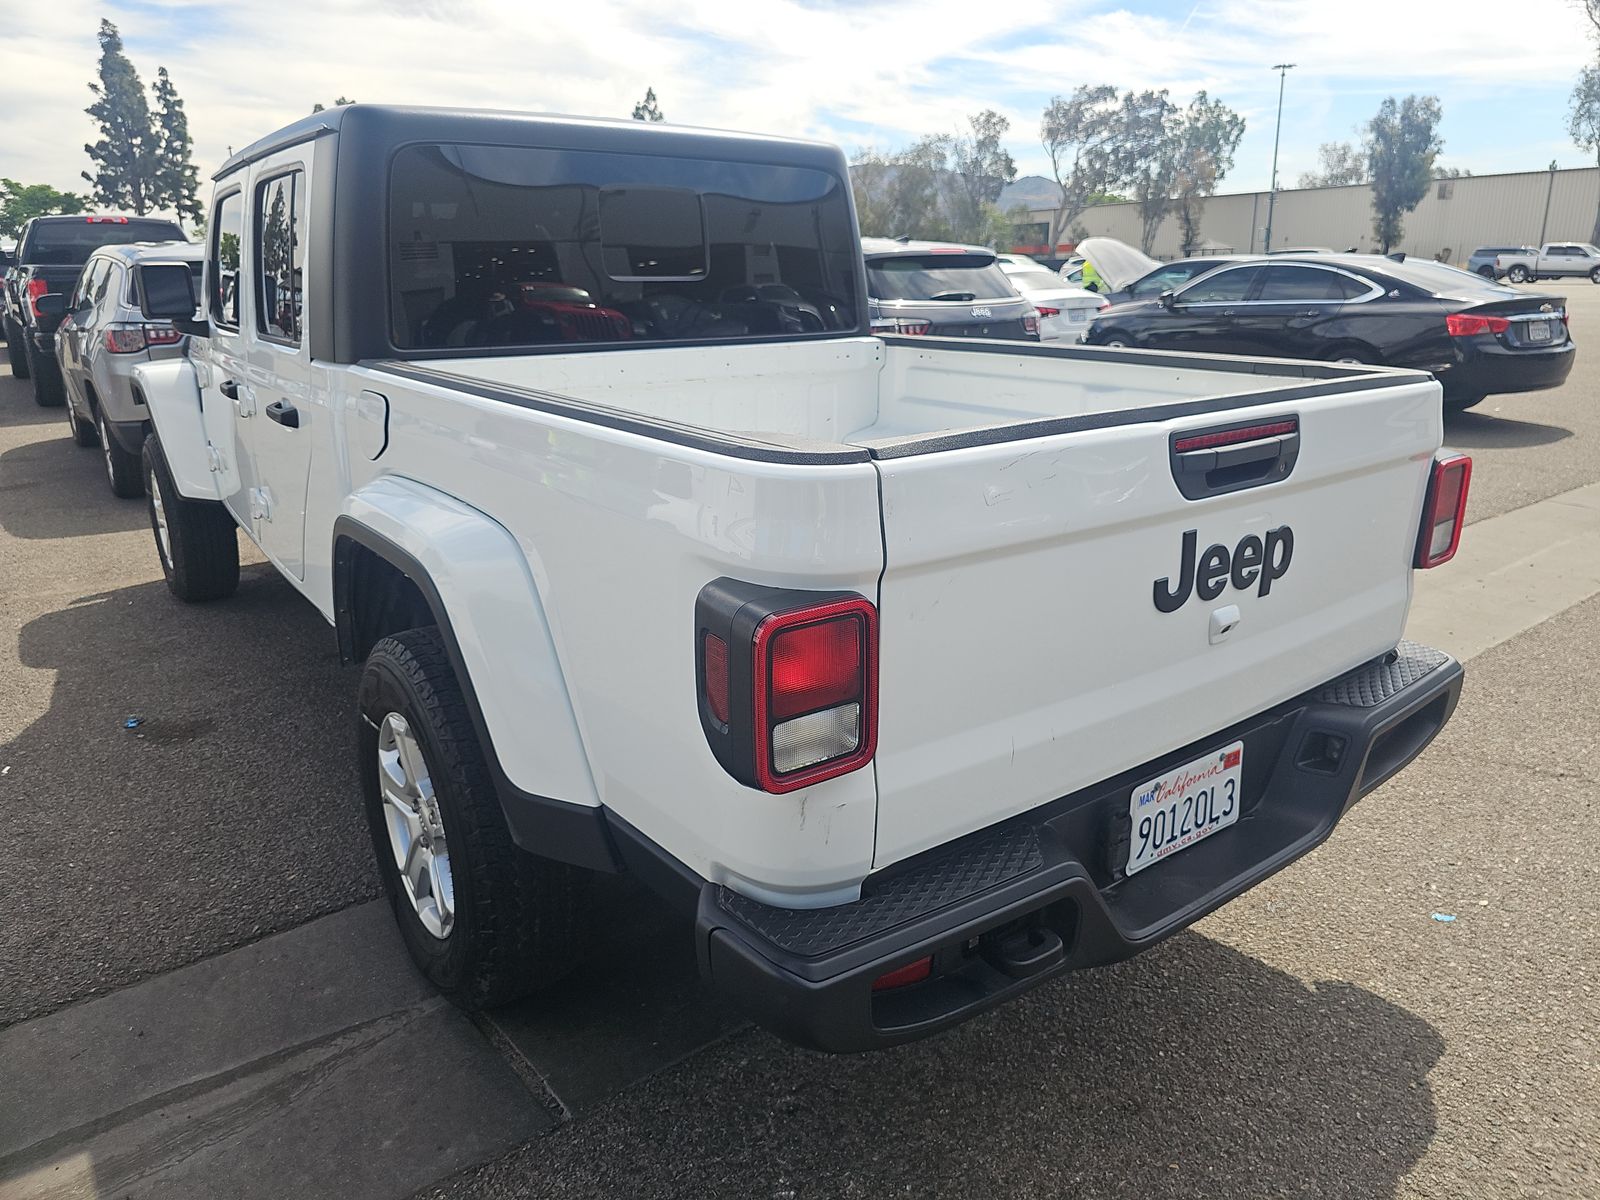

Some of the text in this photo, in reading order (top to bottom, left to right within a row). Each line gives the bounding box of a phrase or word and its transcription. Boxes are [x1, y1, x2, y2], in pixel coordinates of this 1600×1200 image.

[1153, 524, 1294, 613] Jeep
[1139, 791, 1156, 807] MAR
[1156, 764, 1223, 803] California
[1136, 778, 1235, 860] 90120L3
[1156, 824, 1214, 858] dmv.ca.gov
